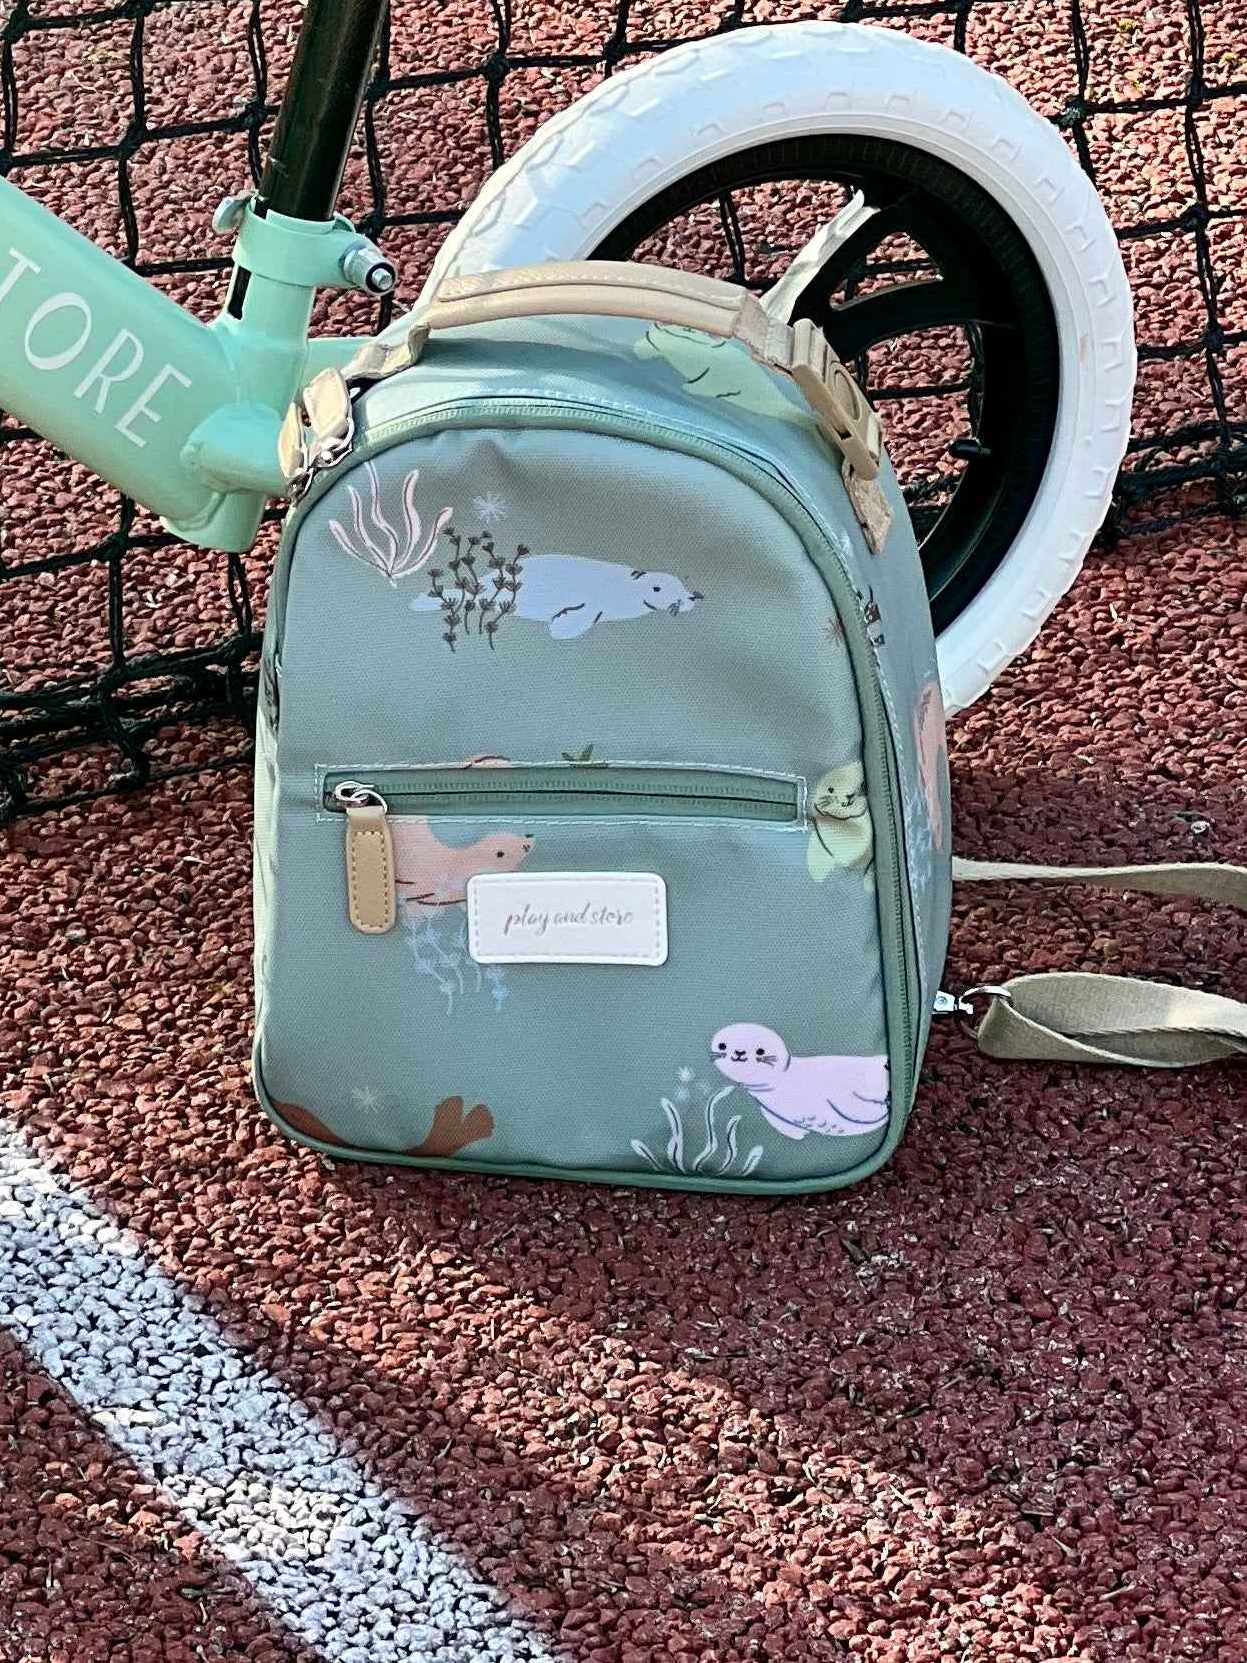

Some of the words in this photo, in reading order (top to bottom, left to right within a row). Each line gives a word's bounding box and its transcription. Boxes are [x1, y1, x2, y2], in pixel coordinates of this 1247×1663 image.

[503, 903, 550, 936] play
[553, 902, 591, 925] and
[592, 905, 634, 926] store
